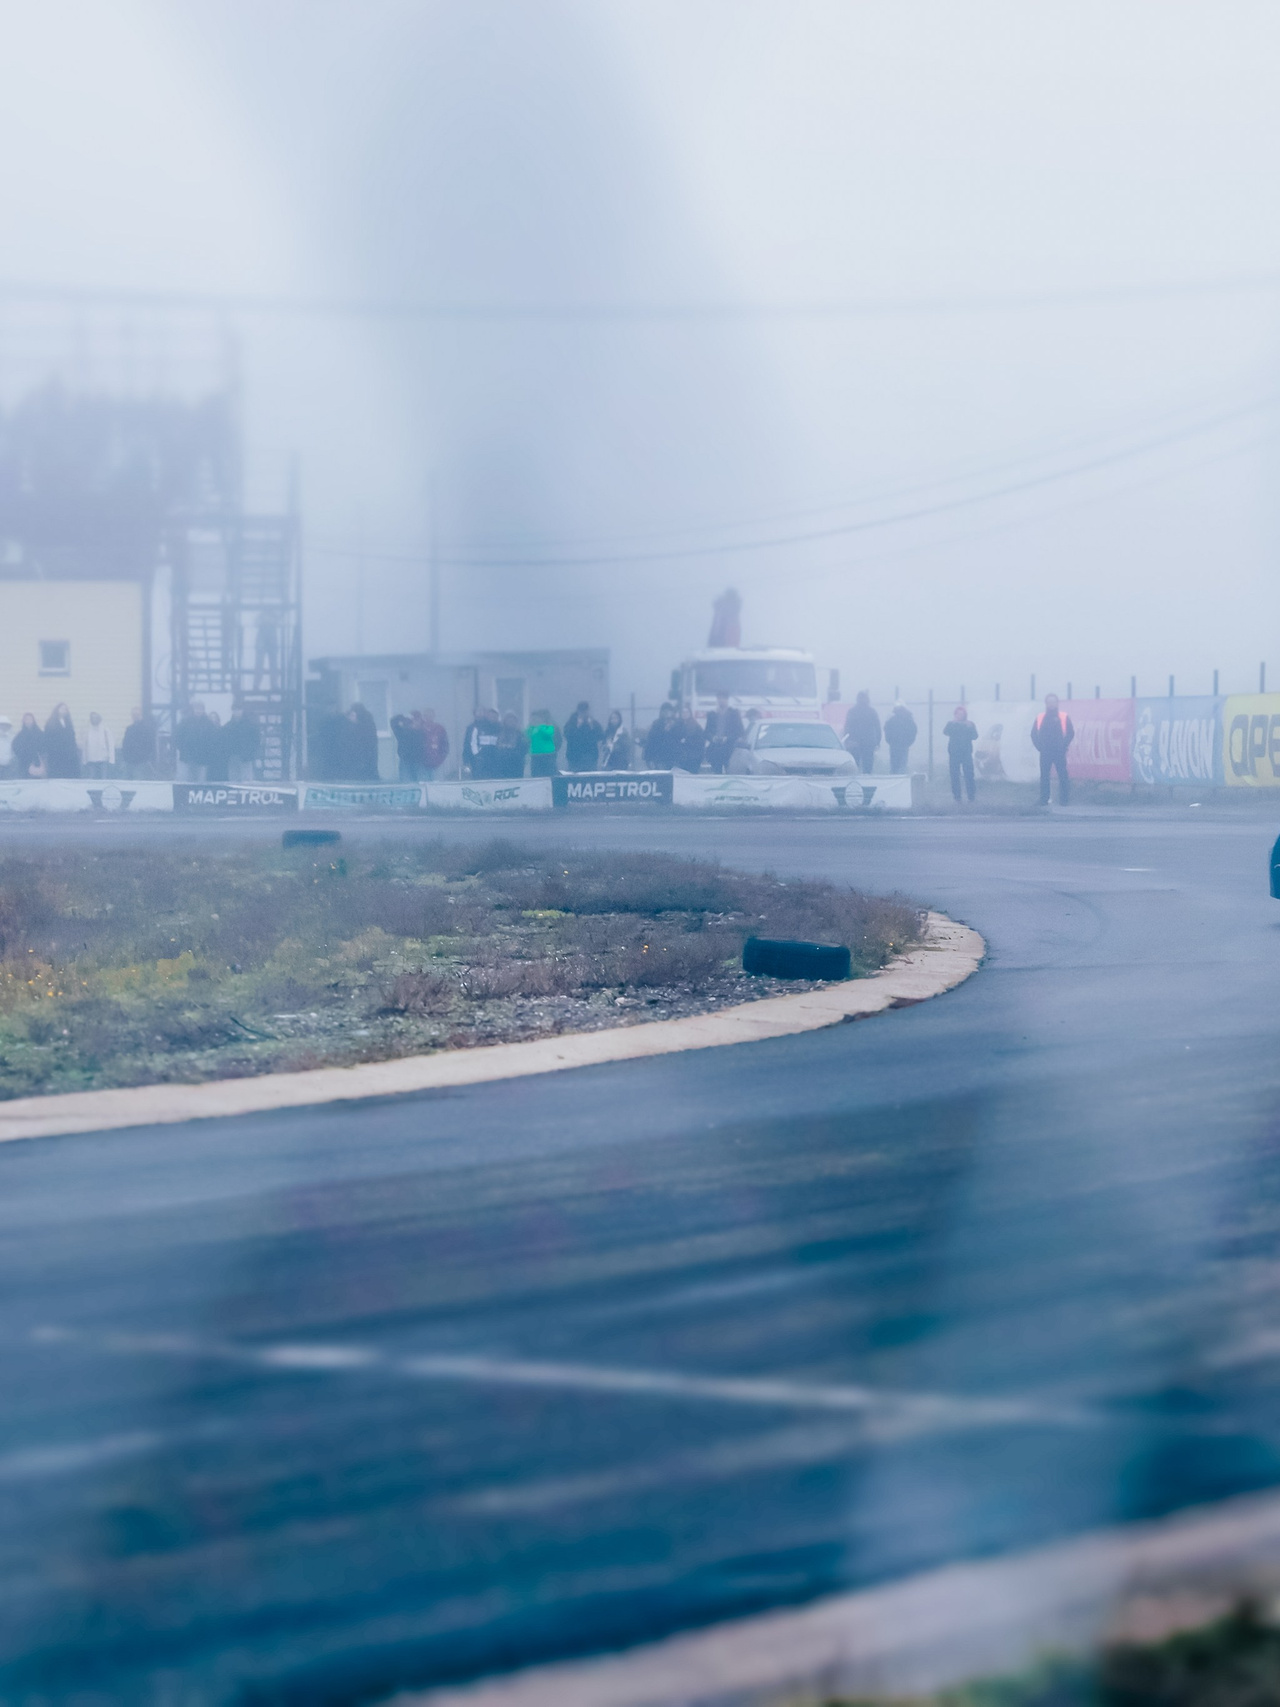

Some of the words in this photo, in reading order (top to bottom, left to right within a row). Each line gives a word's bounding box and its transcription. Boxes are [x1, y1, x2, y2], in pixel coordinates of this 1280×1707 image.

[1159, 718, 1216, 779] RAVON
[188, 789, 284, 804] MAPETROL
[567, 781, 663, 798] MAPETROL
